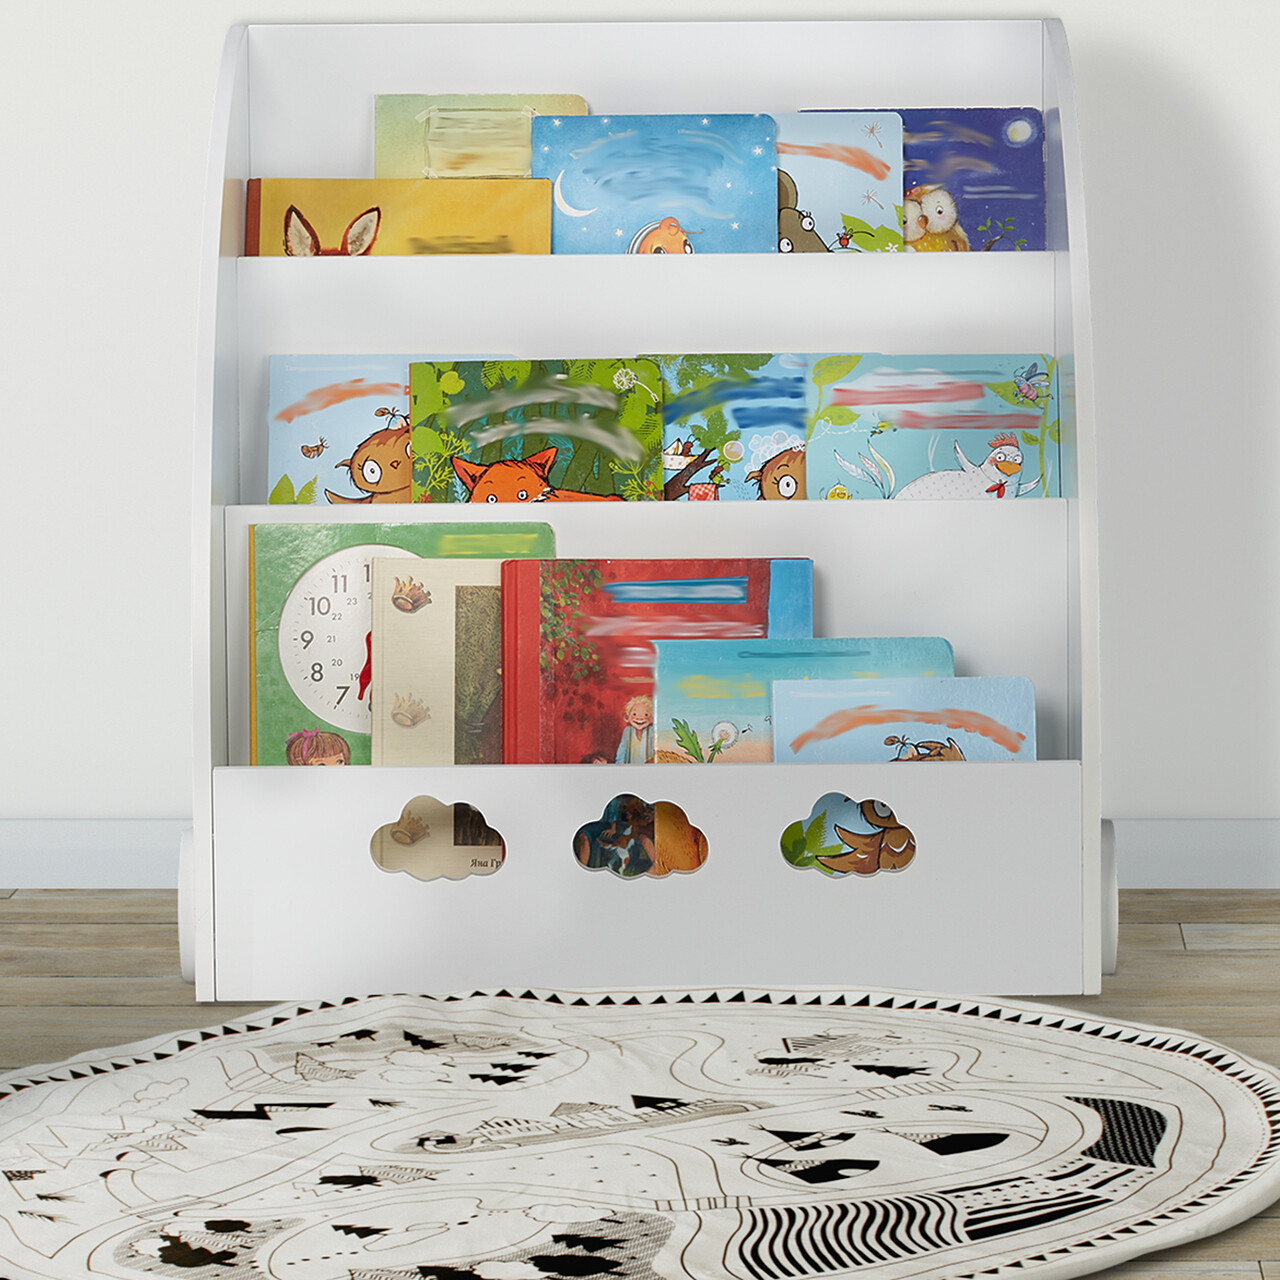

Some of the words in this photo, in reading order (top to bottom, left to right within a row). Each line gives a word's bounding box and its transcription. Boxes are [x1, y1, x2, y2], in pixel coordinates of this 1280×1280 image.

[331, 574, 347, 593] 11
[308, 596, 331, 616] 10
[346, 597, 358, 606] 23
[331, 613, 343, 621] 22
[300, 630, 314, 650] 9
[327, 635, 336, 643] 21
[331, 658, 343, 667] 20
[311, 662, 324, 682] 8
[350, 673, 360, 681] 19
[336, 685, 350, 705] 7
[470, 858, 489, 868] Яна
